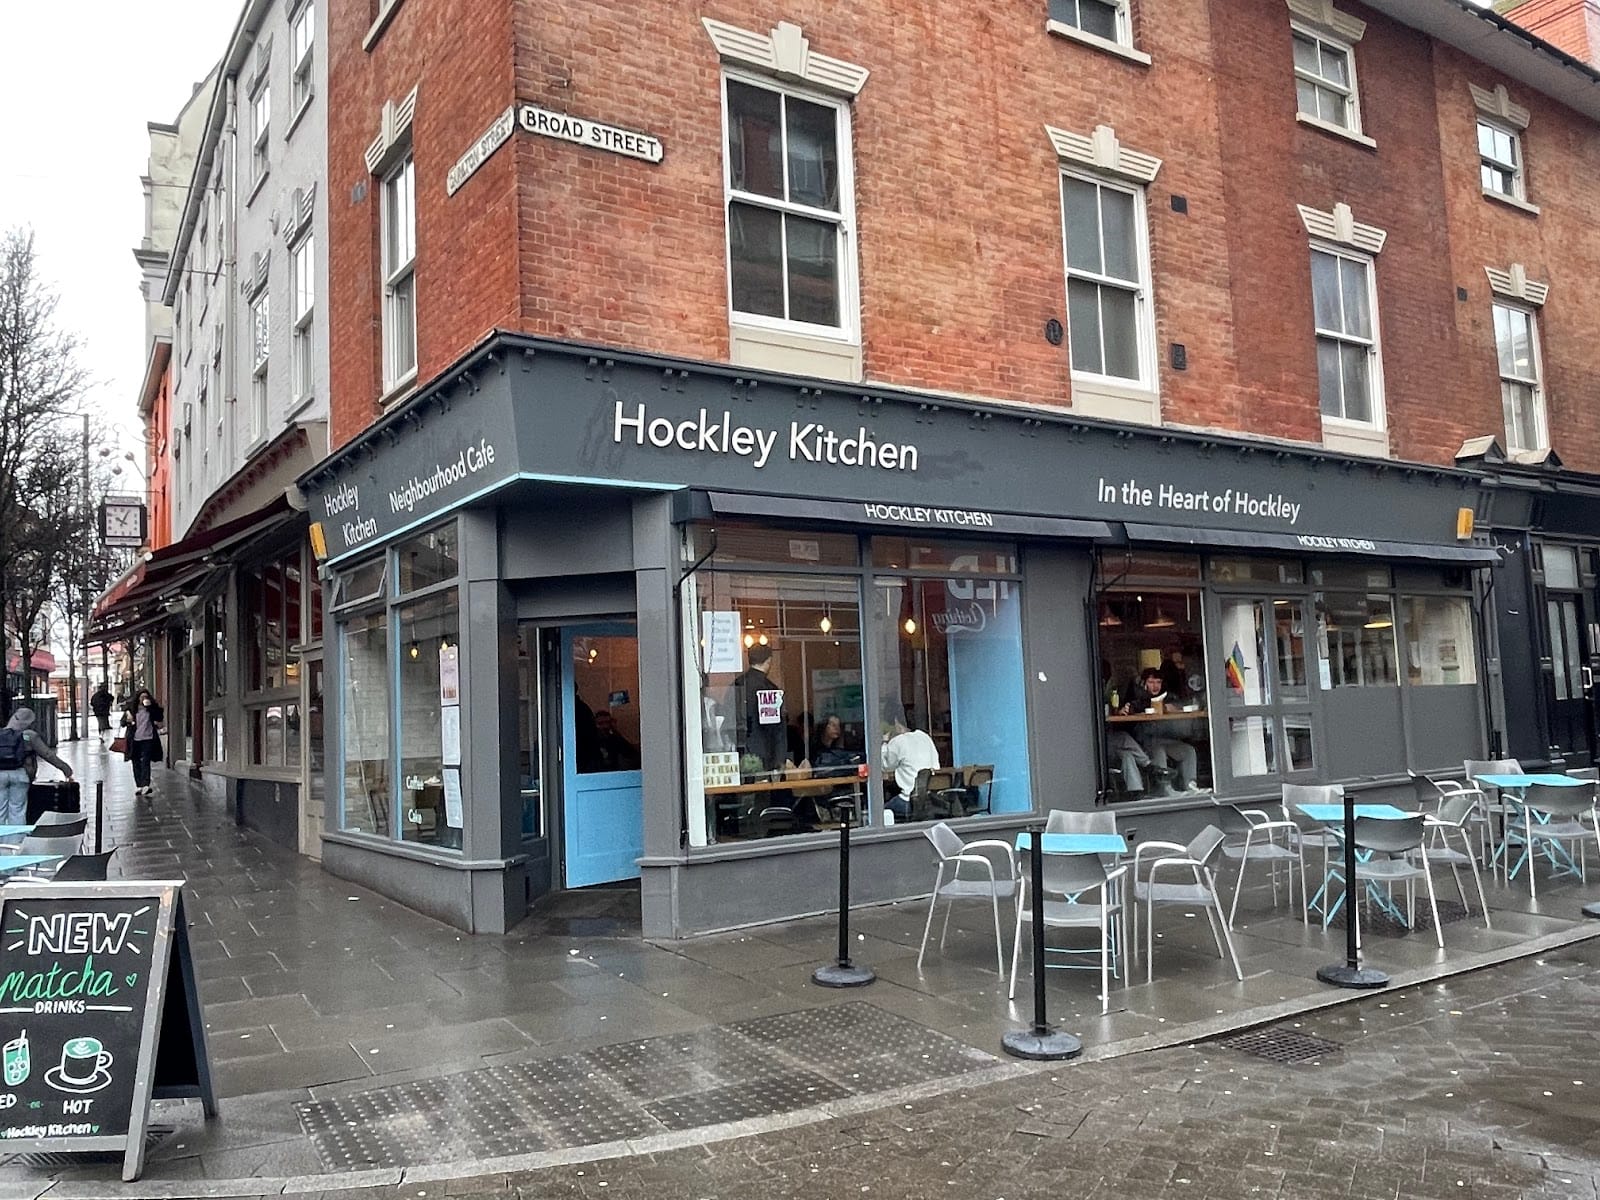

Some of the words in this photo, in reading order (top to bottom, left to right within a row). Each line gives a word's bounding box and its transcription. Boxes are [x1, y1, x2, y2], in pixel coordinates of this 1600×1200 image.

[526, 110, 583, 138] BROAD
[592, 126, 657, 157] STREET
[614, 400, 778, 468] Hockley
[789, 421, 918, 471] Kitchen
[389, 451, 467, 514] Neighbourhood
[467, 438, 495, 473] Cafe
[324, 483, 359, 517] Hockley
[864, 503, 931, 522] HOCKLEY
[934, 509, 993, 527] KITCHEN
[1098, 478, 1116, 503] In
[1121, 479, 1153, 506] the
[1158, 484, 1209, 511] Heart
[1212, 489, 1232, 513] of
[1234, 491, 1300, 525] Hockley
[342, 515, 378, 547] Kitchen
[1297, 535, 1338, 548] HOCKLEY
[758, 691, 778, 704] TAKE
[28, 912, 133, 955] NEW
[34, 1000, 86, 1015] DRINKS
[62, 1099, 94, 1115] HOT
[7, 1125, 47, 1139] Hockley
[47, 1123, 92, 1136] Kitchen
